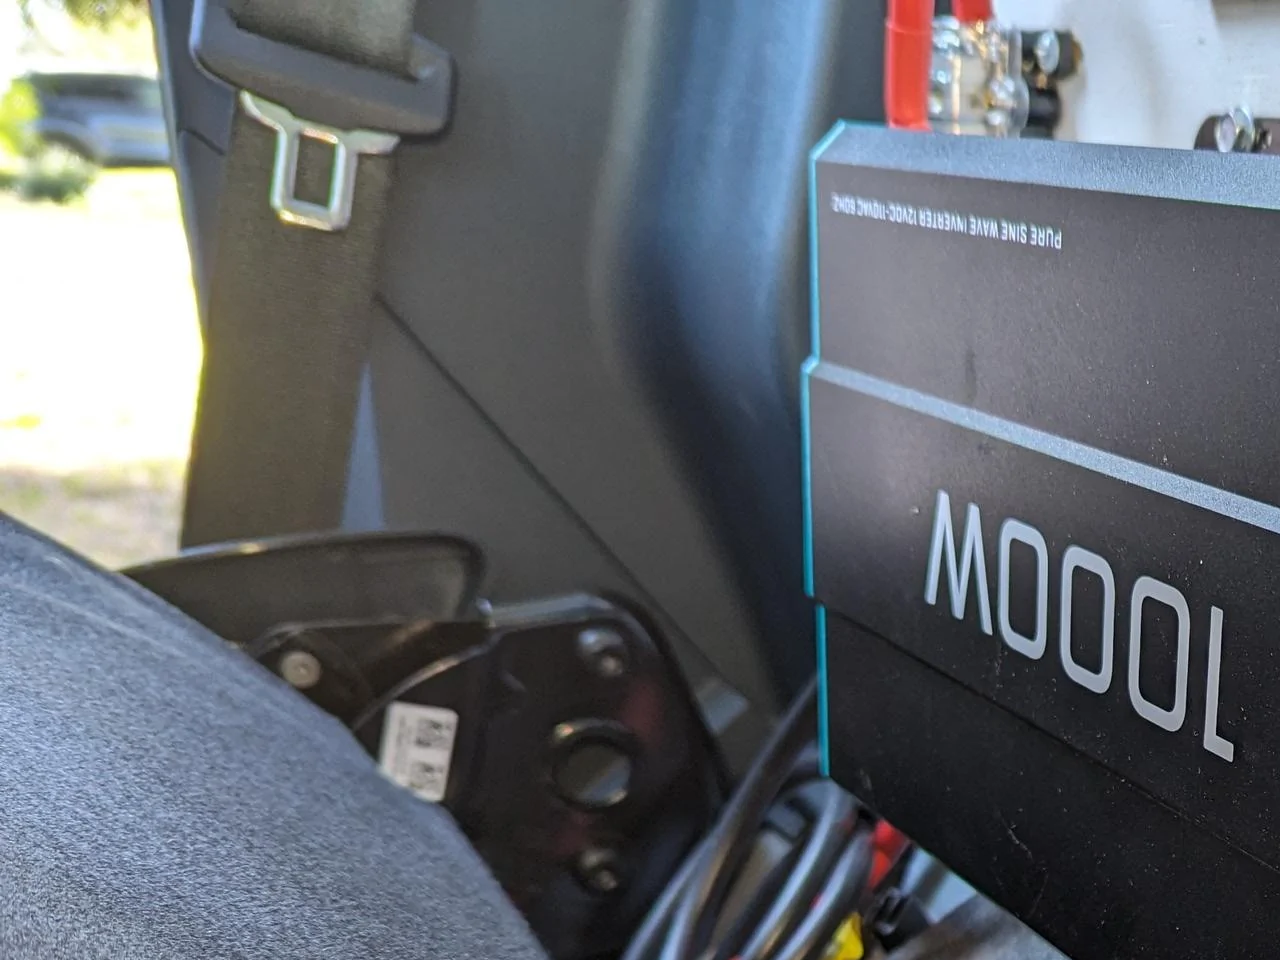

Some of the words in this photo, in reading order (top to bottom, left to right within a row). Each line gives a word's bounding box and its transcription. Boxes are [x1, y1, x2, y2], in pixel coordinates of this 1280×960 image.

[920, 207, 968, 236] INVERTER
[968, 214, 1000, 240] WAVE
[1000, 218, 1028, 244] SINE
[1030, 223, 1062, 250] PURE
[924, 489, 1234, 763] 1000W
